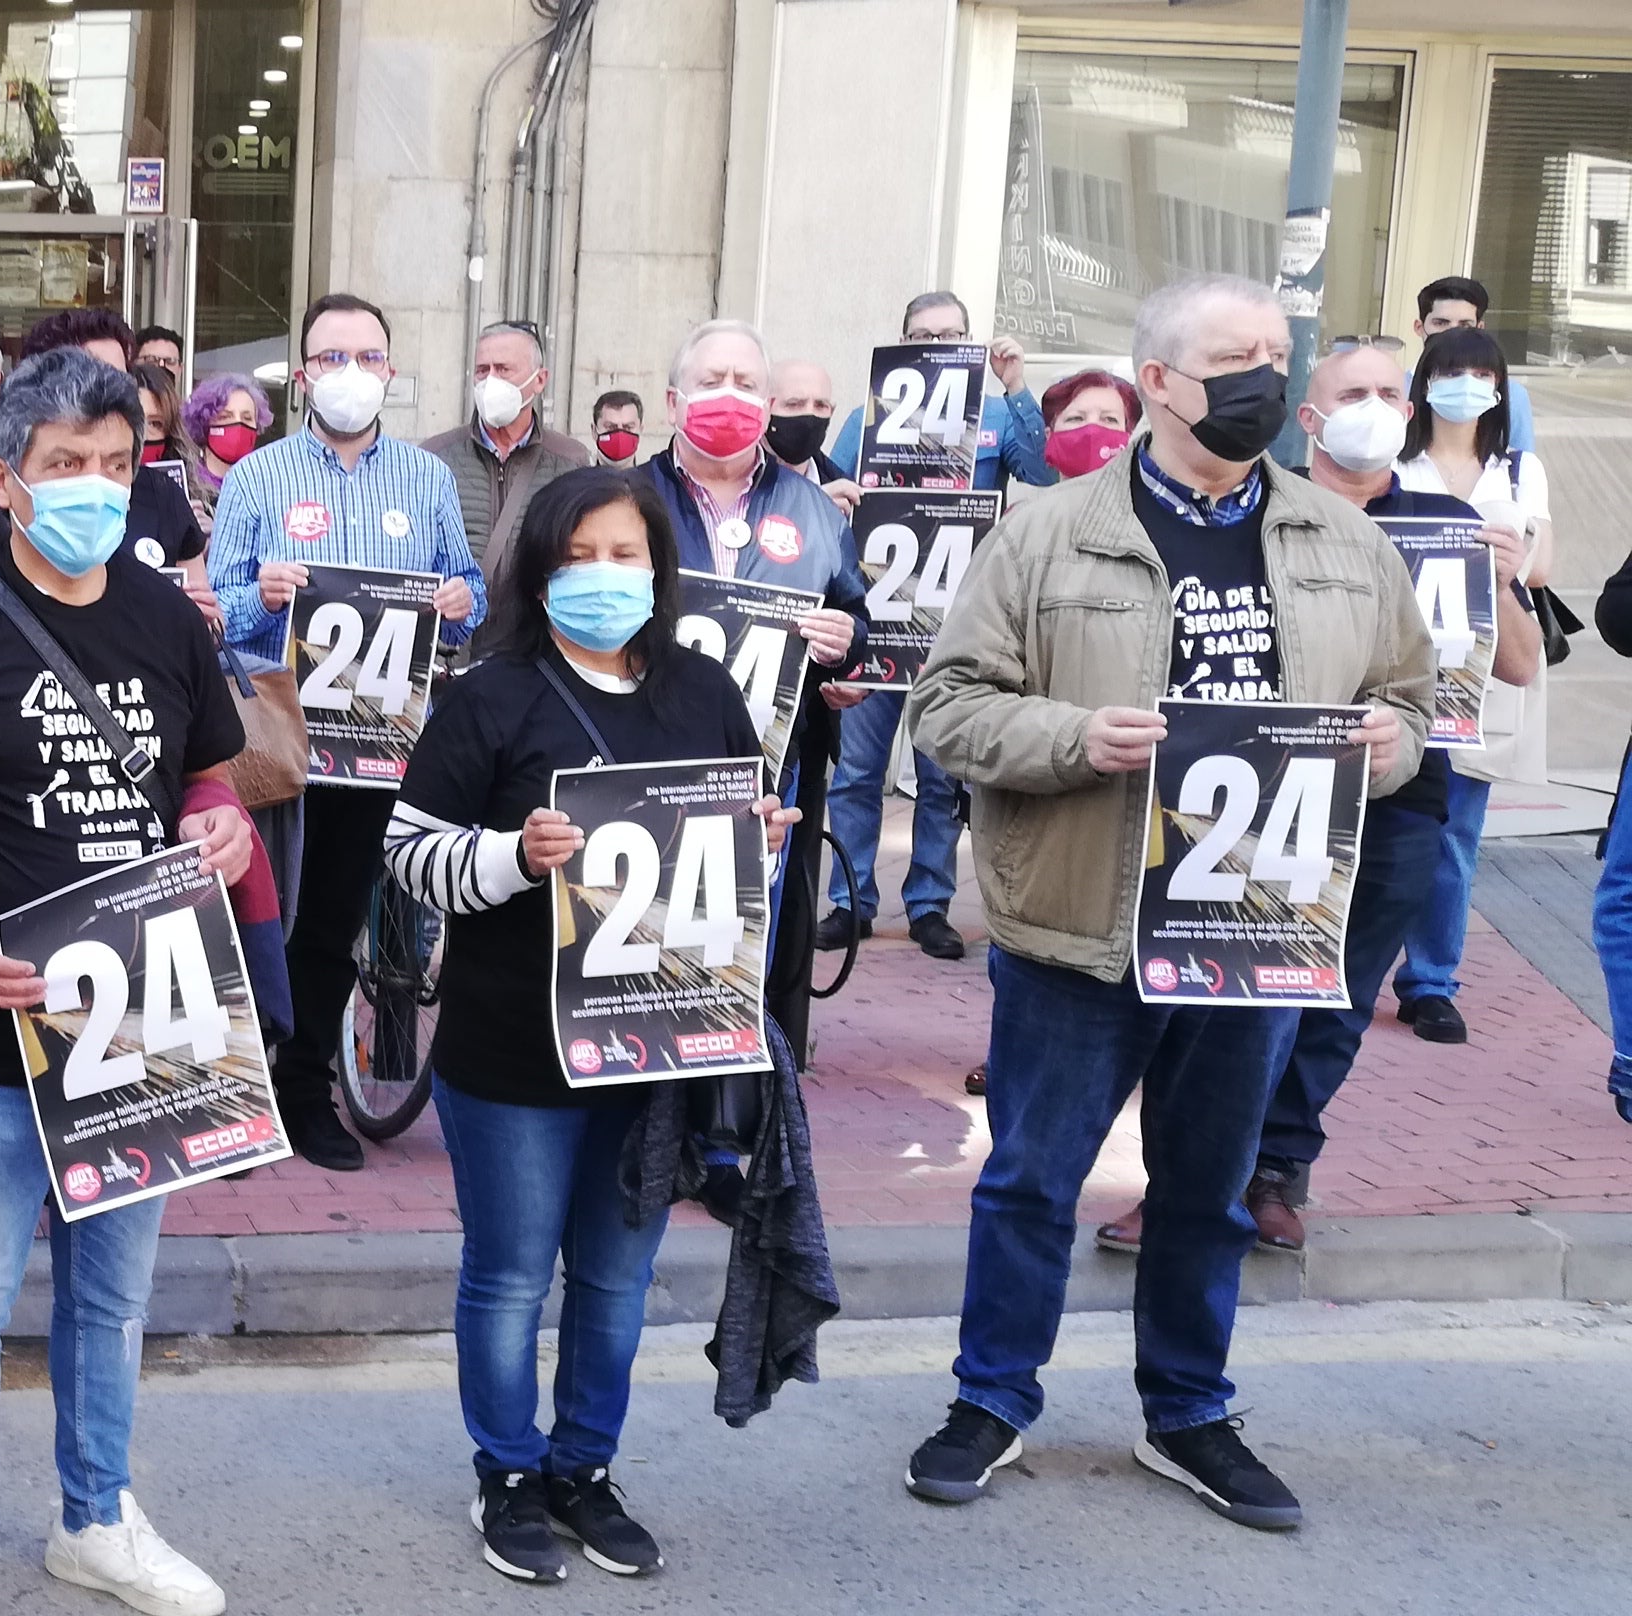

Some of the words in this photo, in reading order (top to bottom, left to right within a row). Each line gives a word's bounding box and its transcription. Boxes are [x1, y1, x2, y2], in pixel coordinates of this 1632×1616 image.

[876, 367, 969, 446] 24
[863, 523, 974, 622] 24
[1226, 586, 1255, 608] DE
[1260, 586, 1272, 604] L
[1180, 640, 1194, 659] Y
[1203, 630, 1272, 655] SALUD
[299, 602, 418, 716] 24
[1234, 657, 1262, 677] EL
[38, 742, 53, 764] Y
[61, 737, 117, 762] SALU
[89, 765, 116, 785] EL
[660, 783, 706, 794] Internacional
[707, 783, 717, 791] de
[718, 782, 725, 790] la
[719, 770, 731, 780] de
[732, 769, 753, 779] abril
[661, 795, 668, 804] la
[669, 793, 706, 805] Seguridad
[707, 793, 717, 801] en
[718, 792, 726, 800] el
[726, 790, 754, 801] Trabajo
[97, 821, 112, 833] de
[1167, 754, 1336, 905] 24
[82, 846, 127, 857] CCOO
[169, 859, 184, 874] de
[109, 878, 160, 906] Internacional
[159, 875, 171, 888] de
[171, 872, 181, 885] la
[112, 902, 122, 914] la
[121, 888, 163, 913] Seguridad
[162, 886, 174, 898] en
[173, 883, 183, 894] el
[183, 873, 214, 893] Trabajo
[582, 814, 744, 978] 24
[1258, 968, 1313, 986] CCOO
[44, 906, 231, 1101] 24
[681, 1033, 734, 1053] CCOO
[62, 1122, 106, 1145] accidente
[106, 1118, 119, 1131] de
[119, 1109, 151, 1129] trabajo
[151, 1106, 164, 1118] en
[163, 1103, 174, 1114] la
[73, 1108, 116, 1132] personas
[158, 1093, 171, 1105] en
[171, 1089, 181, 1101] el
[188, 1125, 249, 1156] CCOO
